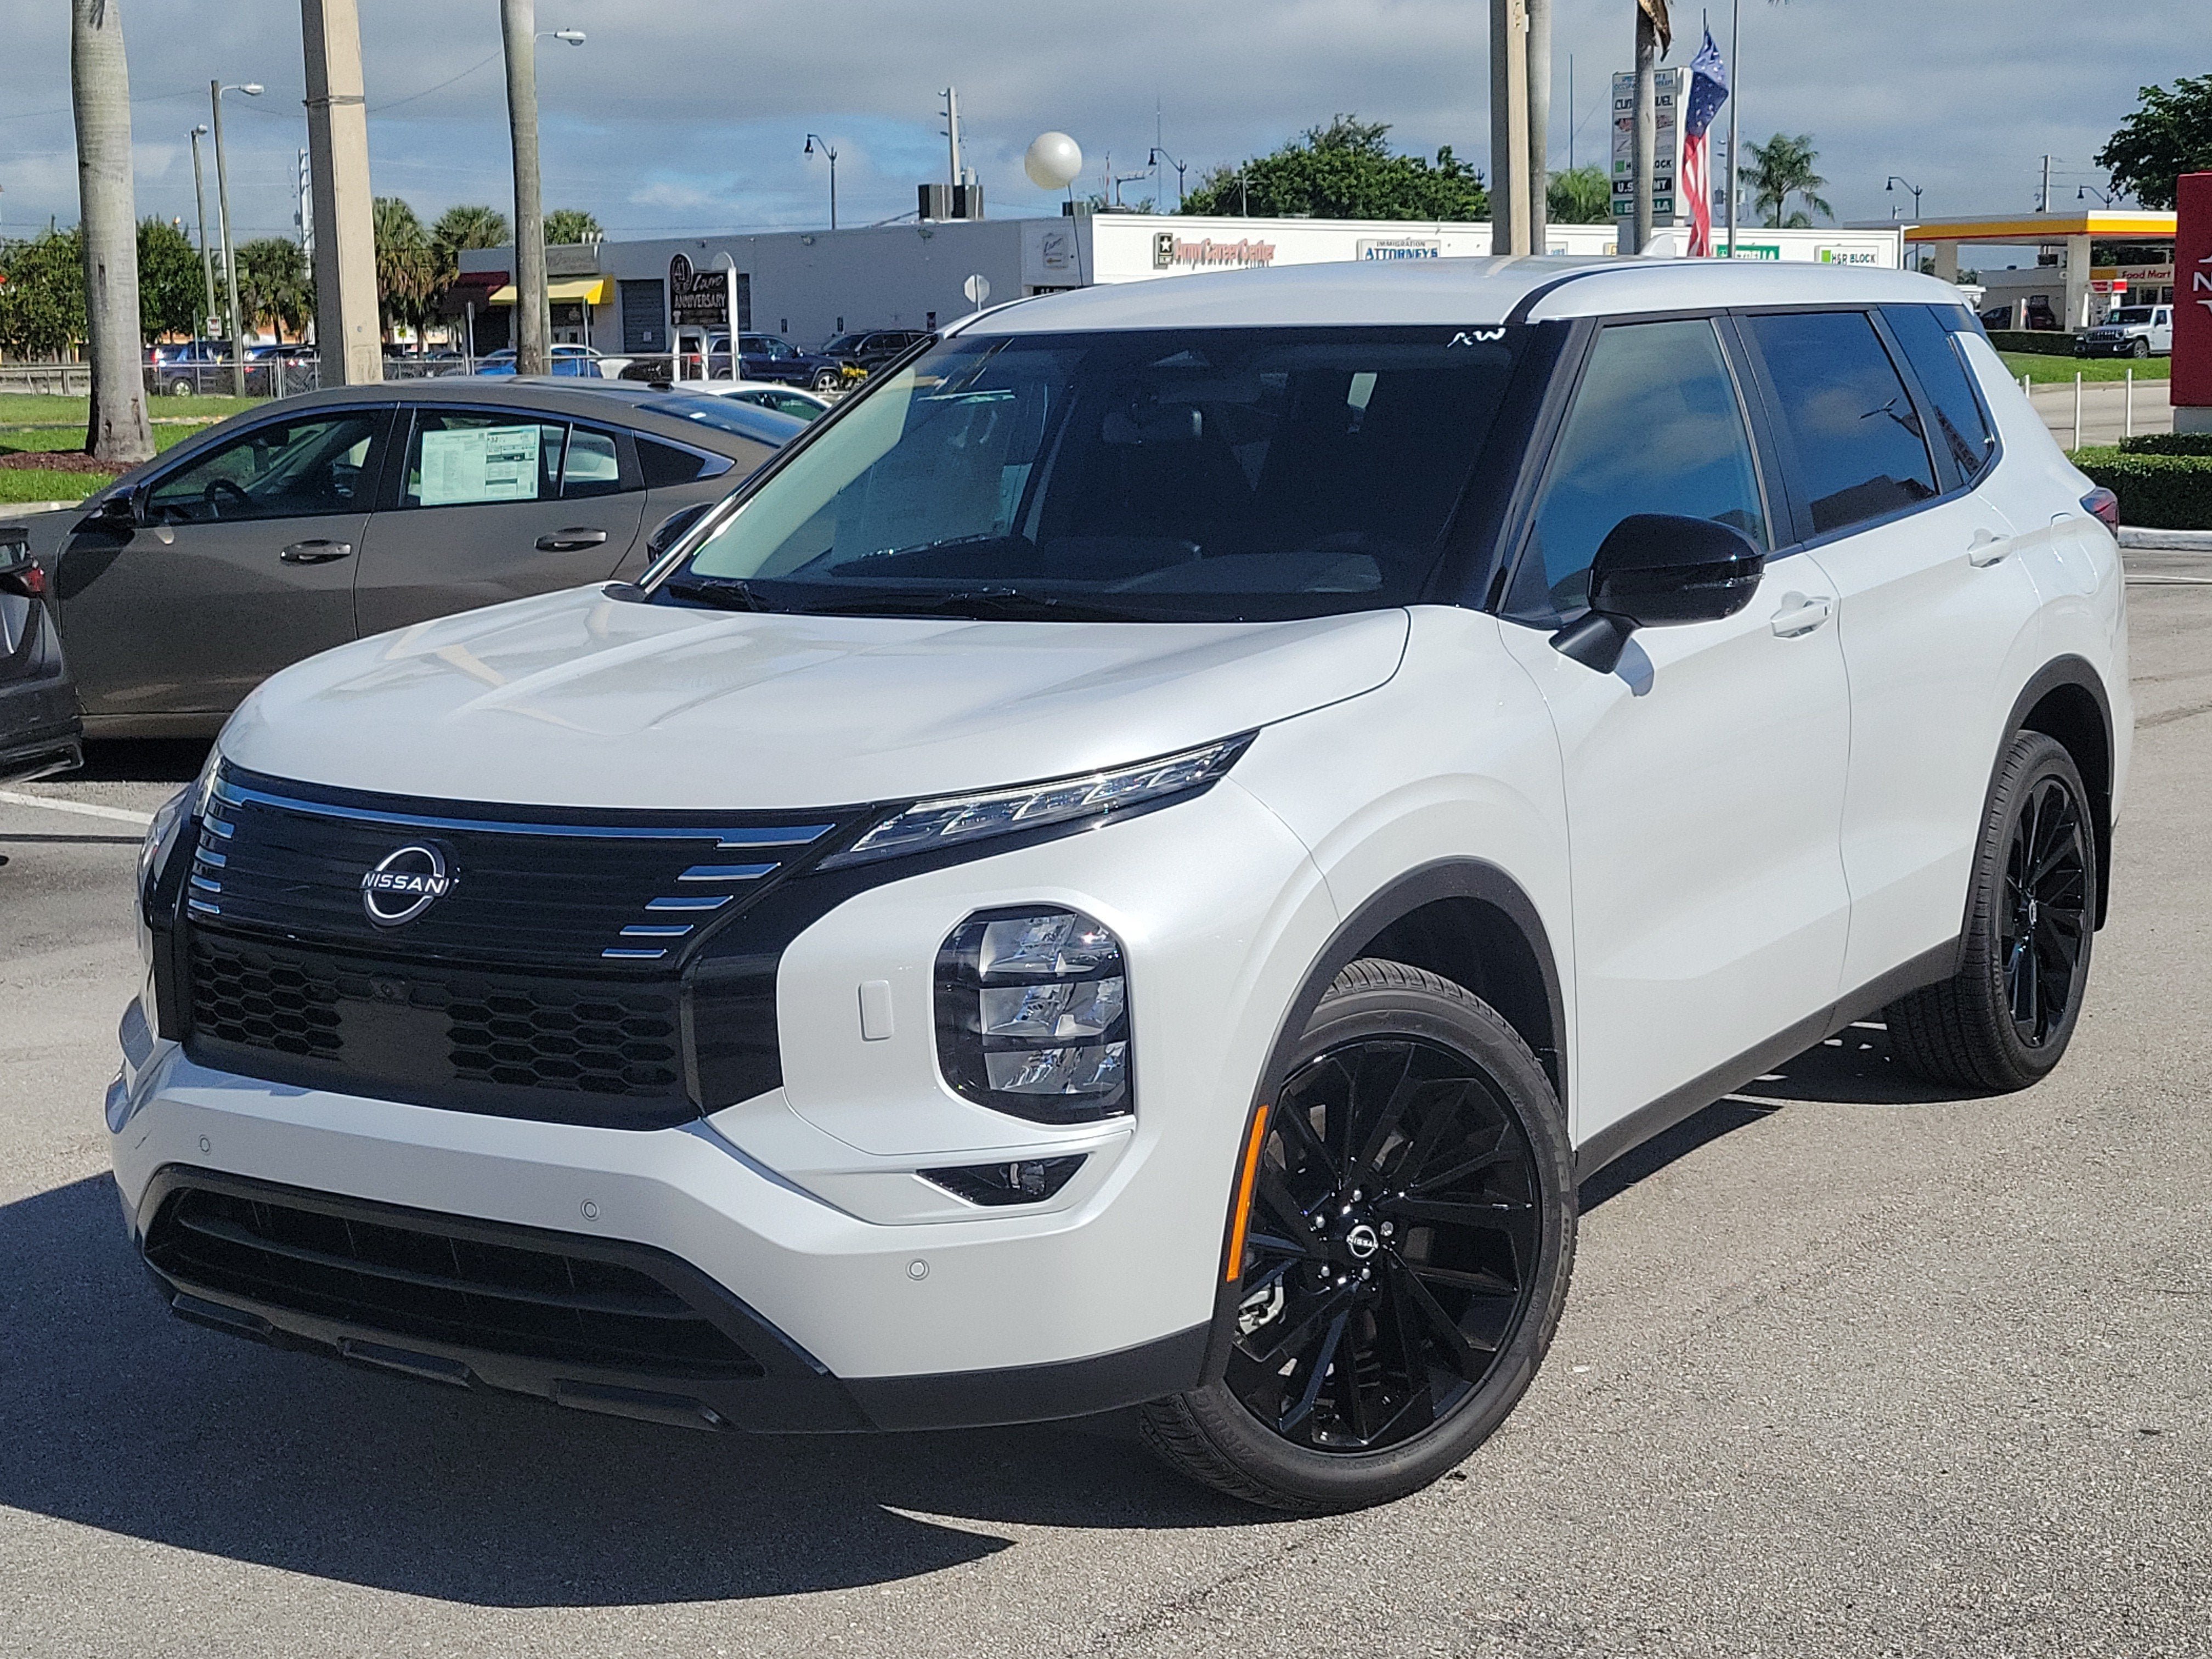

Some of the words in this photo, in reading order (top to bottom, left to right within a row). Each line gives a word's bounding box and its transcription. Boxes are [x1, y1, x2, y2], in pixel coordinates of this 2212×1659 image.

[1365, 247, 1438, 261] ATTORNEYS
[1849, 253, 1876, 263] BLOCK
[2122, 270, 2145, 279] Food
[2148, 269, 2171, 279] Mart
[674, 294, 726, 308] ANNIVERSARY
[362, 872, 445, 894] NISSAN
[1346, 1234, 1379, 1249] NISSAN
